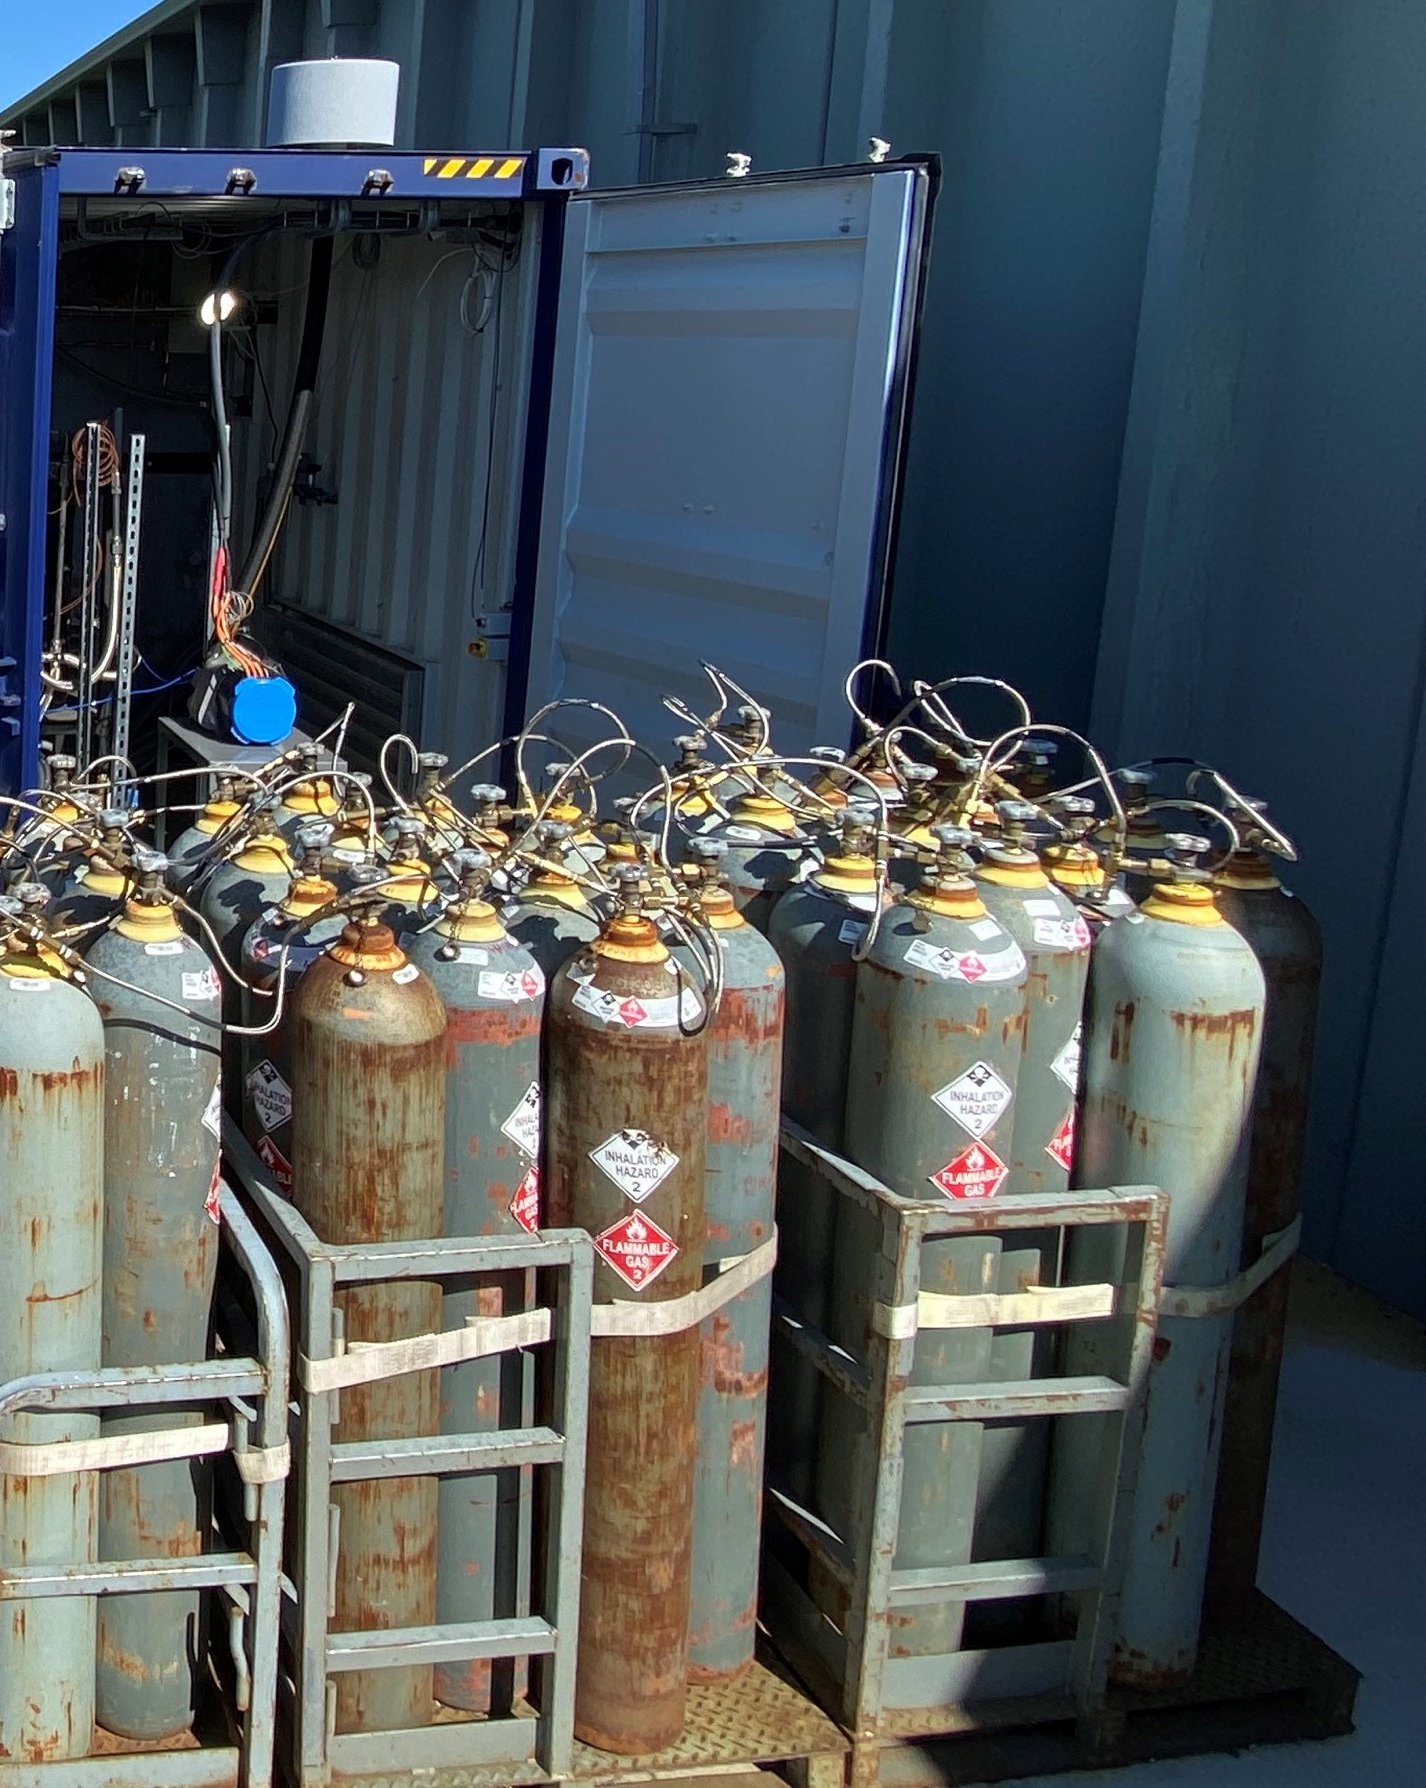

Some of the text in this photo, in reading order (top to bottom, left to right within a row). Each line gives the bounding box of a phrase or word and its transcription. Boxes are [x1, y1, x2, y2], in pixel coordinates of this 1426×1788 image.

[950, 1090, 1004, 1102] INHALATION
[960, 1104, 998, 1115] HAZARD
[265, 1112, 272, 1123] 2
[974, 1119, 983, 1129] 2
[605, 1150, 667, 1165] INHALATION
[616, 1165, 659, 1179] HAZARD
[942, 1168, 1002, 1185] FLAMMABLE
[632, 1182, 641, 1192] 2
[964, 1184, 985, 1197] GAS
[602, 1238, 670, 1256] FLAMMABLE
[625, 1255, 649, 1268] GAS
[633, 1268, 643, 1280] 2
